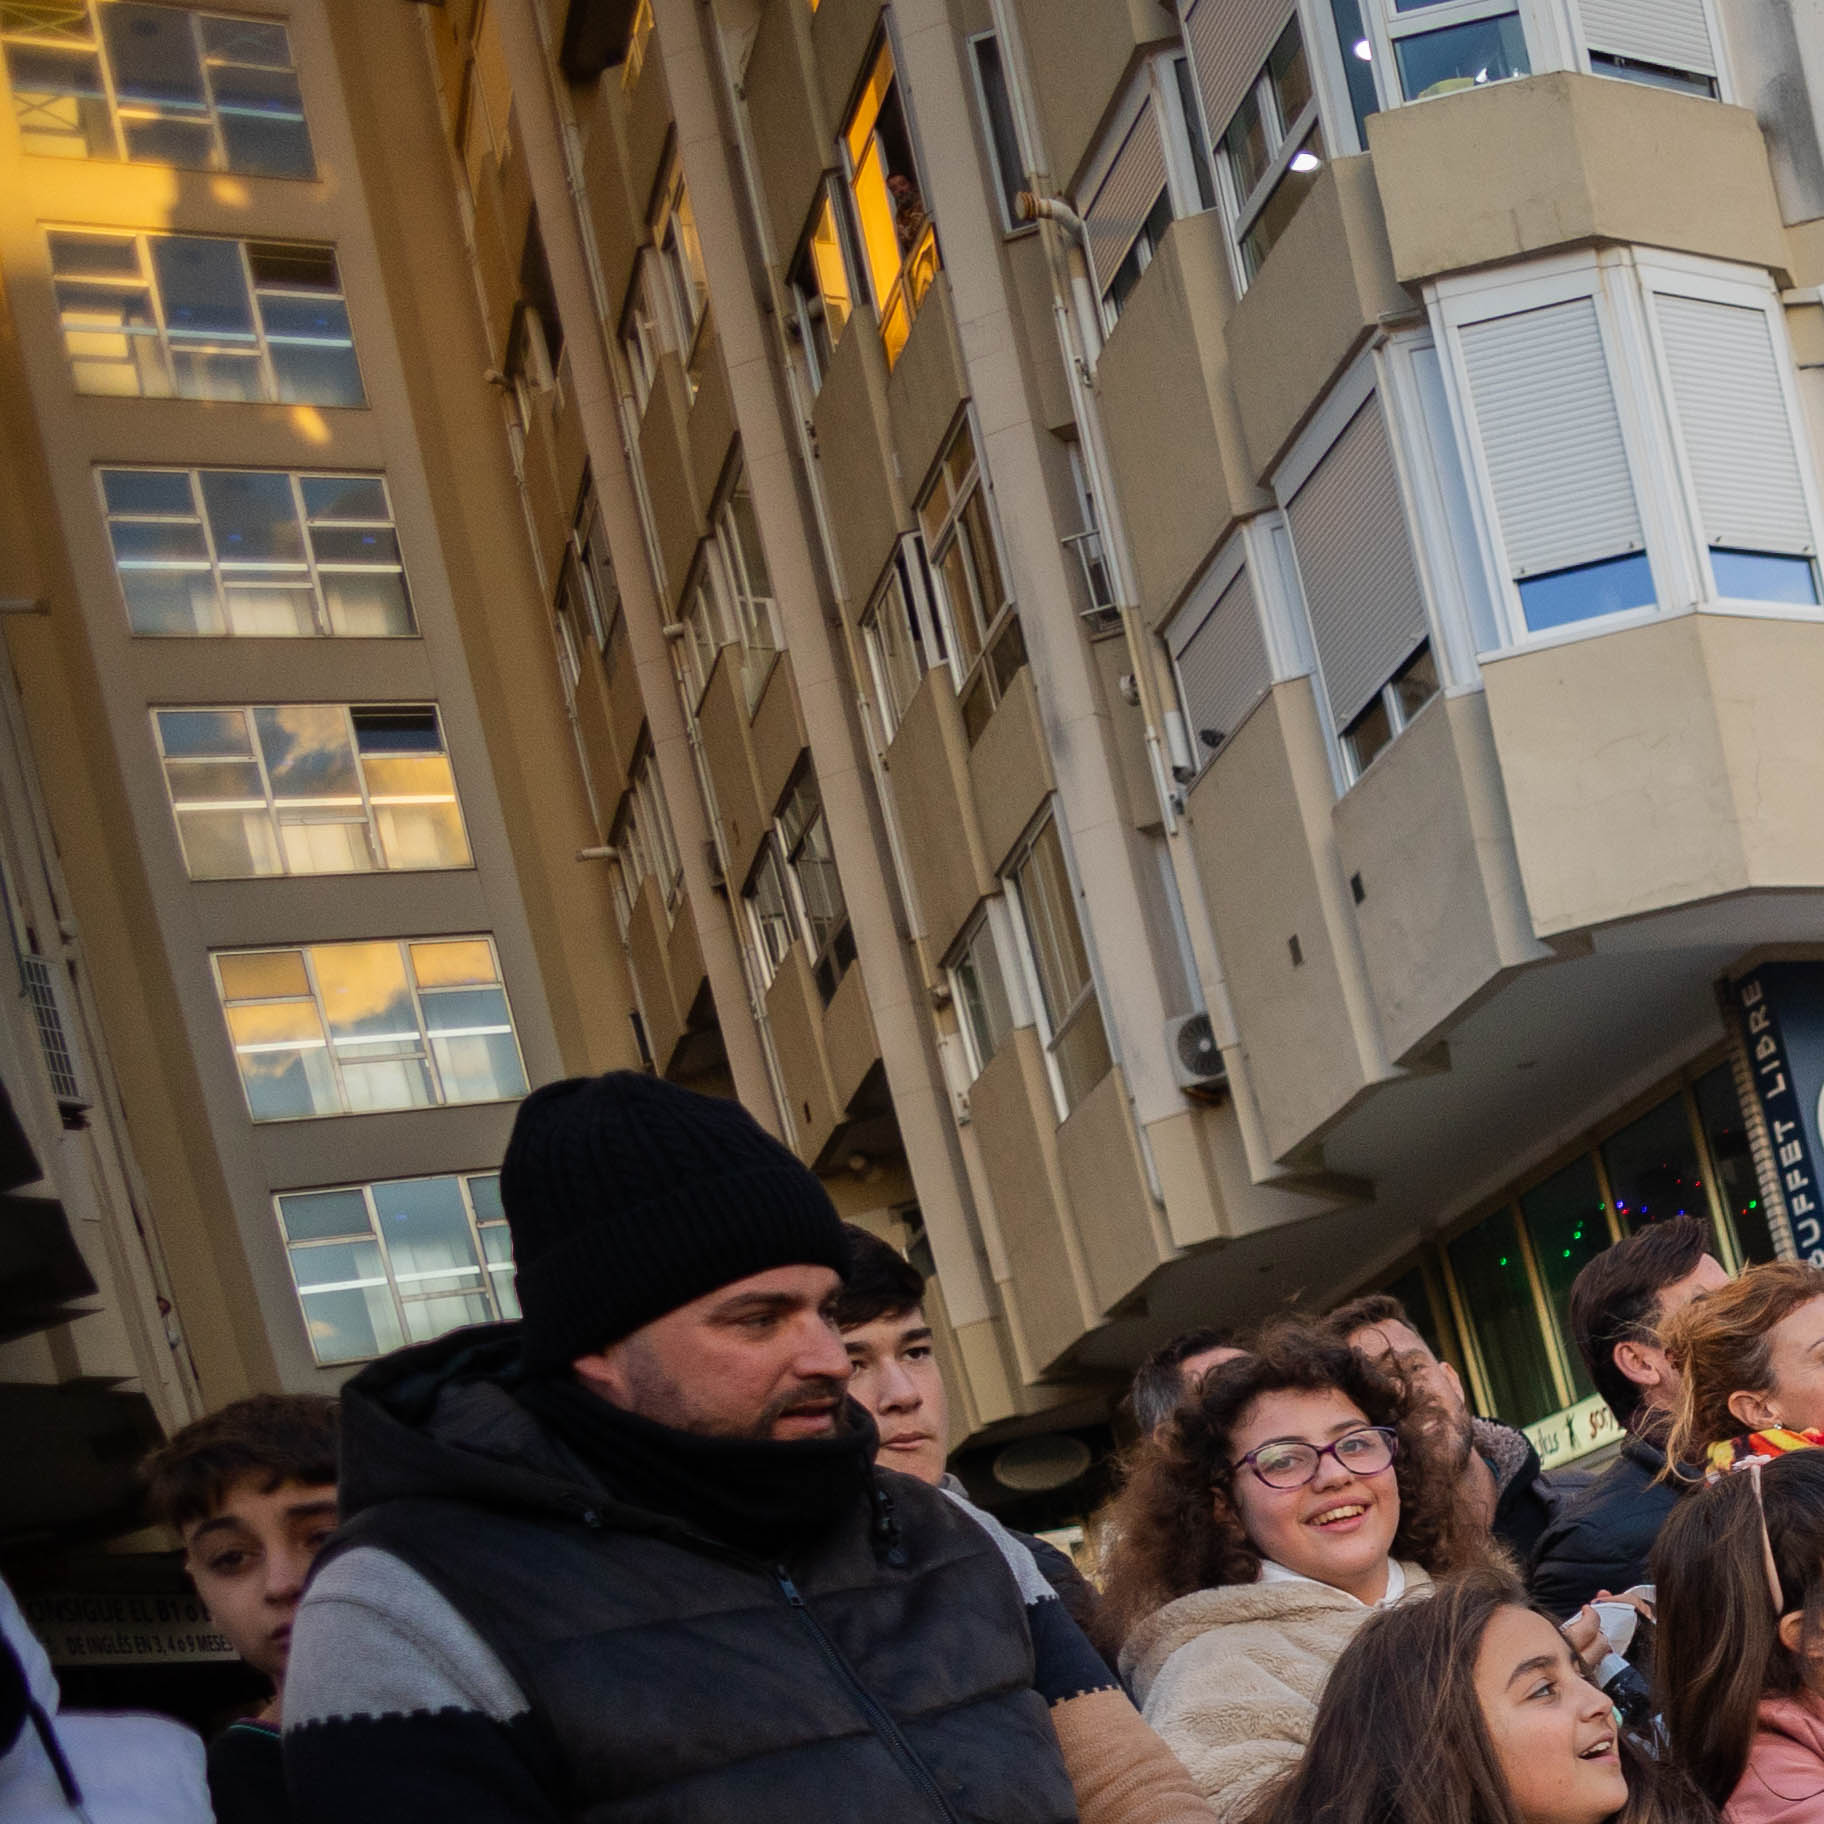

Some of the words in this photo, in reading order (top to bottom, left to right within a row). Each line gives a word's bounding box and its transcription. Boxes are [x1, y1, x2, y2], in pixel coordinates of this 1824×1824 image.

[1741, 980, 1787, 1099] LIBRE
[67, 1636, 86, 1656] DE
[135, 1635, 152, 1655] EN
